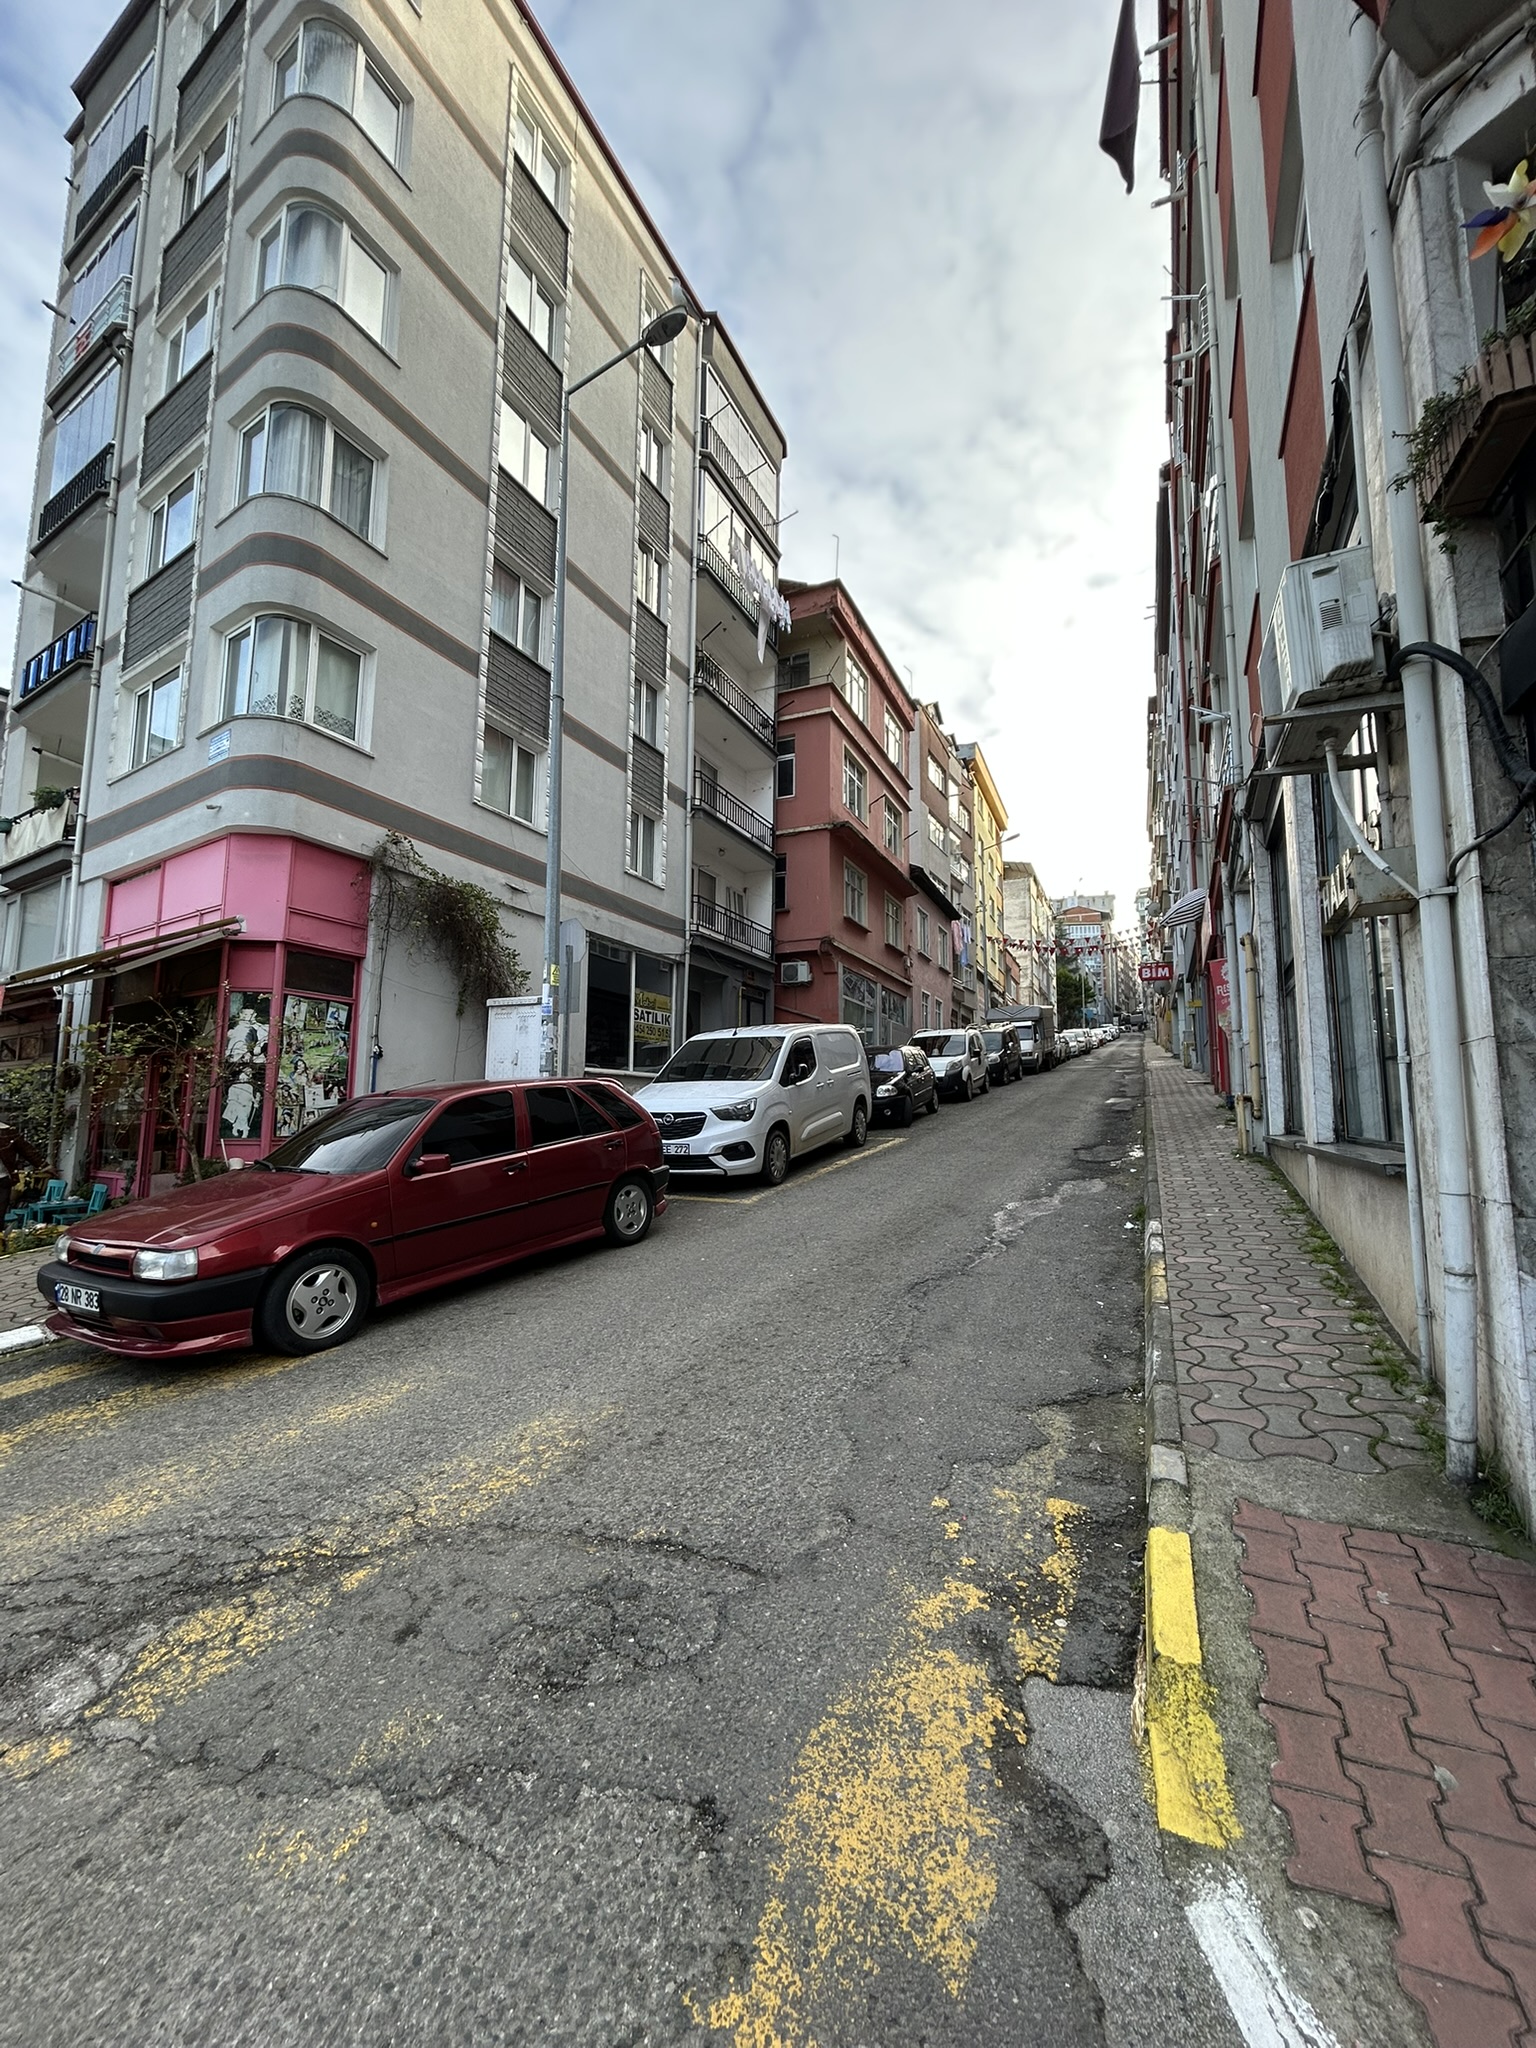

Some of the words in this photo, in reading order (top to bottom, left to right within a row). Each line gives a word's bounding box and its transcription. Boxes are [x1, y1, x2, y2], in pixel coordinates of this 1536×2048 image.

[634, 1007, 671, 1026] SATILIK
[60, 1285, 69, 1302] 28
[71, 1287, 82, 1305] NR
[84, 1290, 99, 1310] 383
